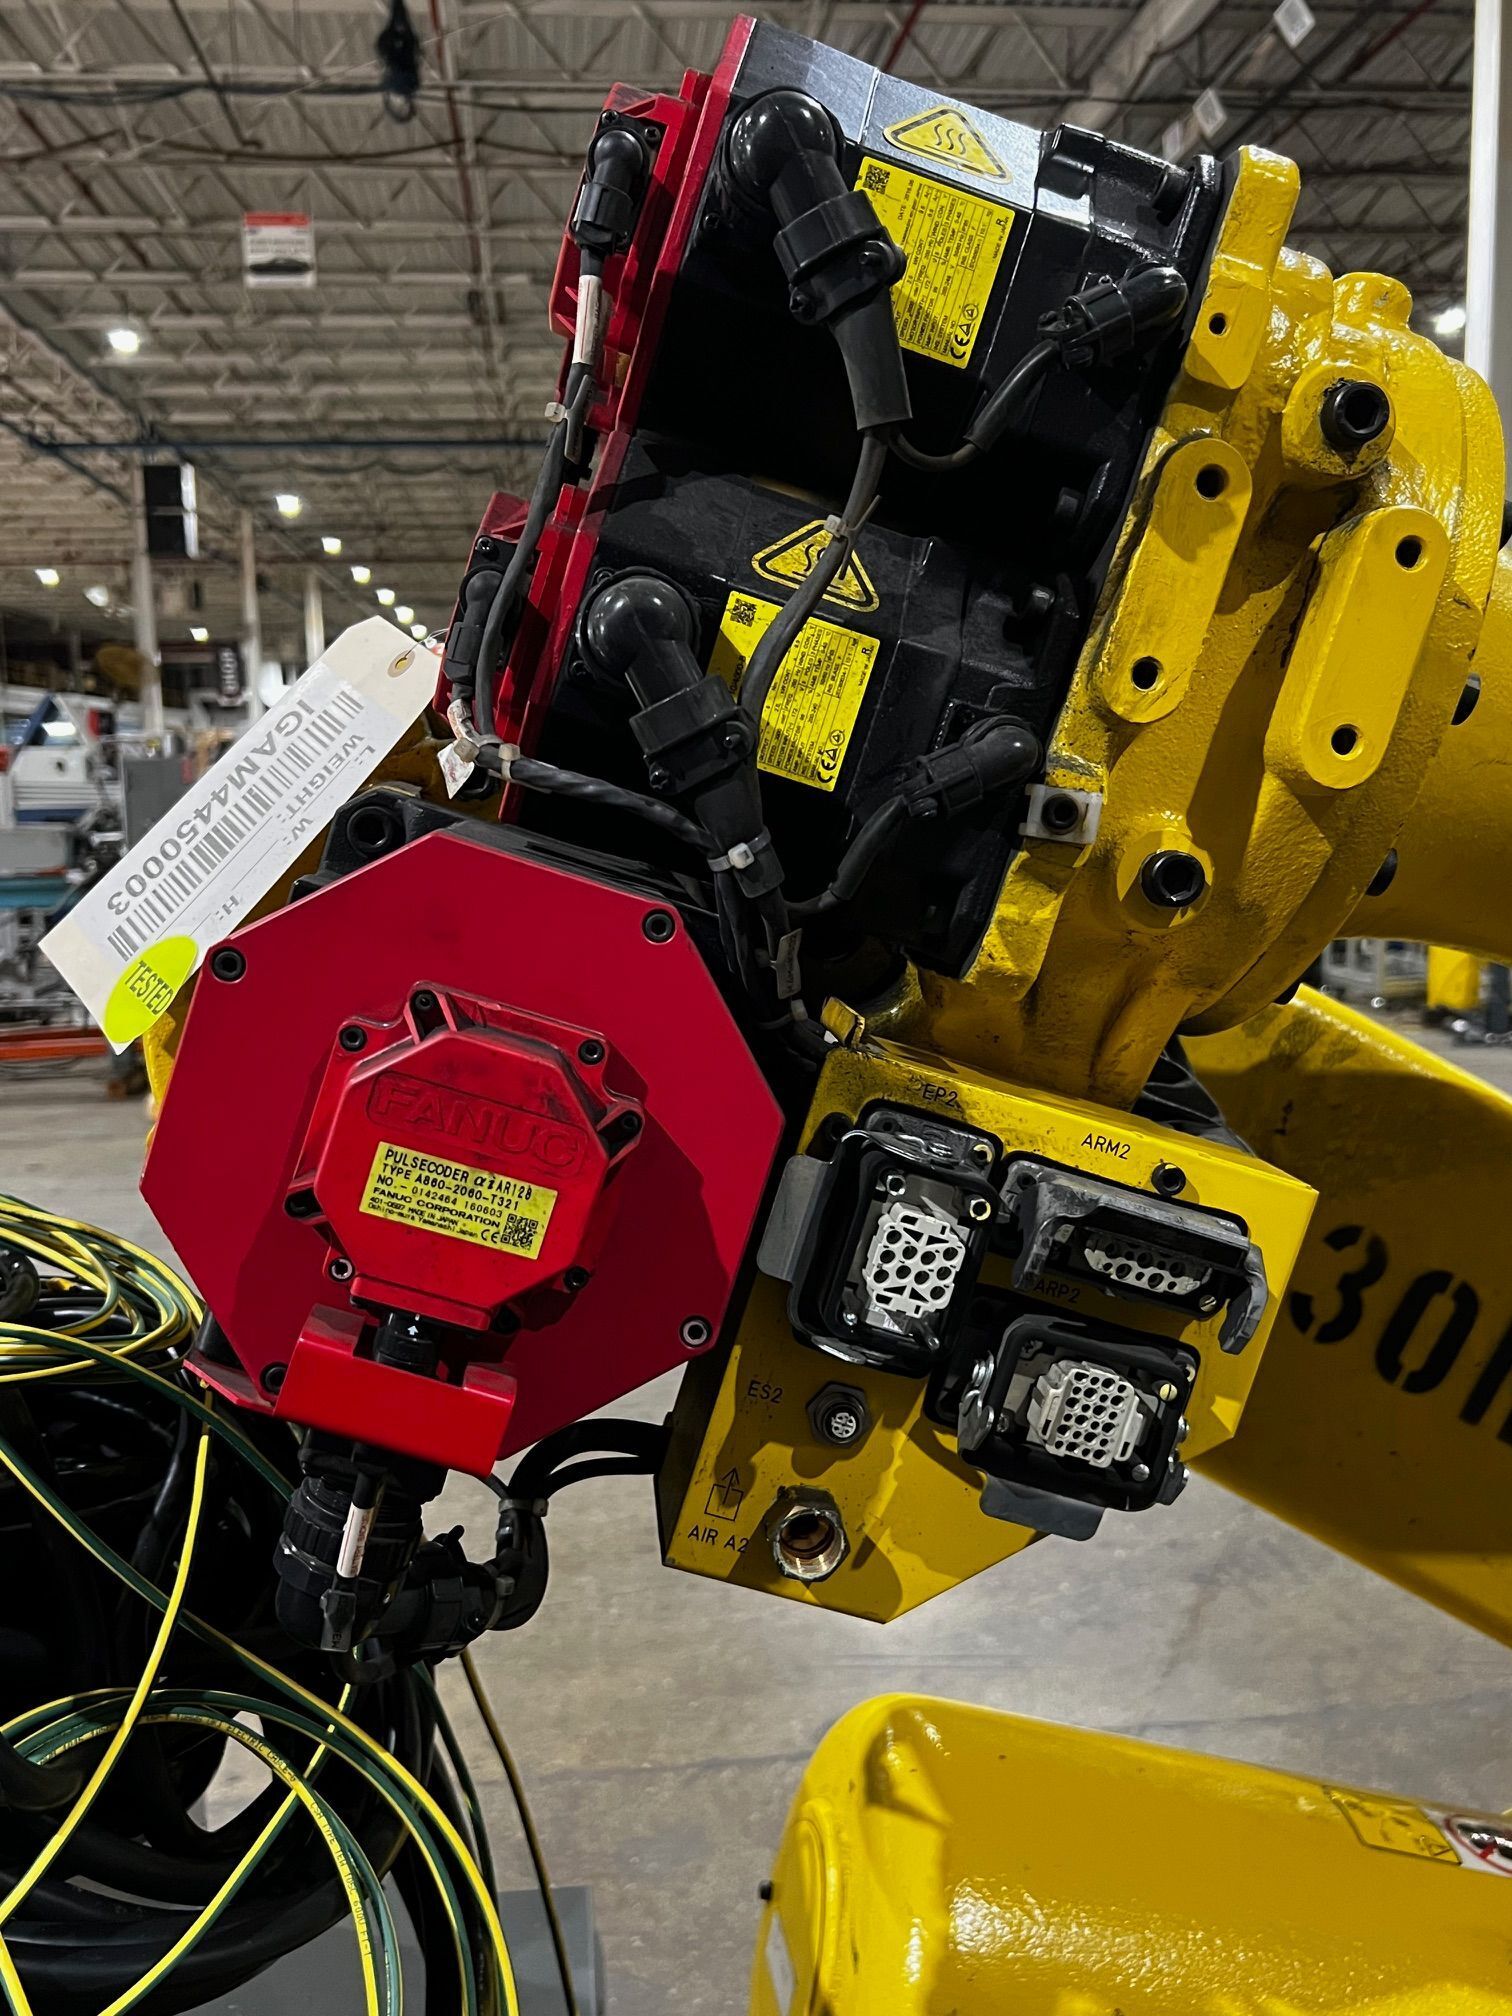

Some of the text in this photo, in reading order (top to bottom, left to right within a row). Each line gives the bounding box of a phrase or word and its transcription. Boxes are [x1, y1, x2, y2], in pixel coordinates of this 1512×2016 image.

[277, 733, 366, 823] WEIGHT:
[108, 699, 312, 915] IGAM4450003
[125, 960, 173, 1015] TESTED
[922, 1083, 958, 1107] EP2
[374, 1077, 583, 1168] FANUC
[1081, 1132, 1131, 1161] ARM2
[383, 1148, 470, 1183] PULSECODER
[380, 1162, 519, 1211] TYPE A860-2060-T321
[410, 1185, 457, 1206] 0142464
[463, 1200, 503, 1218] 160603
[372, 1186, 500, 1228] FANUC CORPORATION
[407, 1206, 425, 1216] MADE
[426, 1211, 435, 1219] IN
[437, 1215, 458, 1226] JAPAN
[1034, 1279, 1080, 1304] ARP2
[748, 1380, 783, 1403] ES2
[688, 1524, 750, 1554] AIR A2
[226, 1722, 266, 1752] ELECTRIC
[308, 1800, 325, 1819] CSA
[321, 1821, 338, 1844] TYPE
